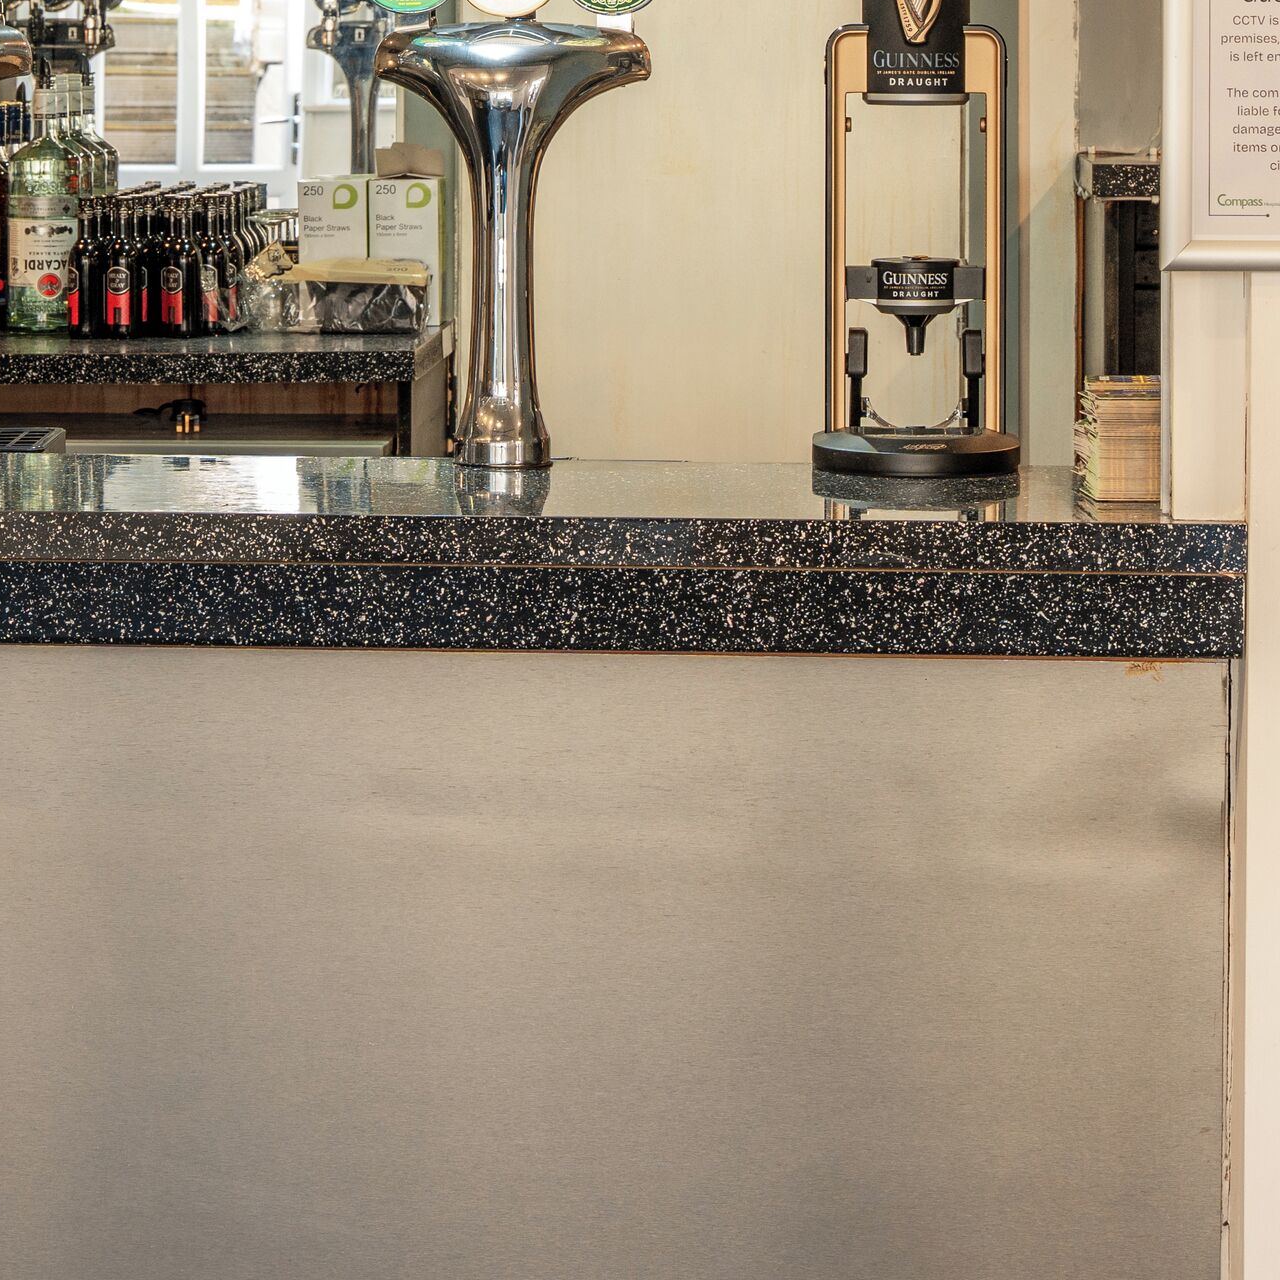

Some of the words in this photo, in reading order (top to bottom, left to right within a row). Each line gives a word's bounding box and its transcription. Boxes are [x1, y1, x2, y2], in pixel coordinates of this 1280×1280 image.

[903, 17, 913, 32] 1759
[1232, 15, 1265, 25] CCTV
[1269, 15, 1279, 25] is
[1221, 34, 1280, 45] premises,
[873, 49, 960, 68] GUINNESS
[1230, 52, 1240, 62] is
[1243, 51, 1263, 62] left
[889, 78, 948, 86] DRAUGHT
[1227, 88, 1249, 98] The
[1237, 106, 1269, 116] liable
[1233, 142, 1267, 153] items
[303, 186, 324, 196] 250
[376, 184, 396, 195] 250
[1217, 194, 1263, 209] Compass
[24, 259, 70, 273] ACARDÍ
[883, 271, 948, 285] GUINNESS
